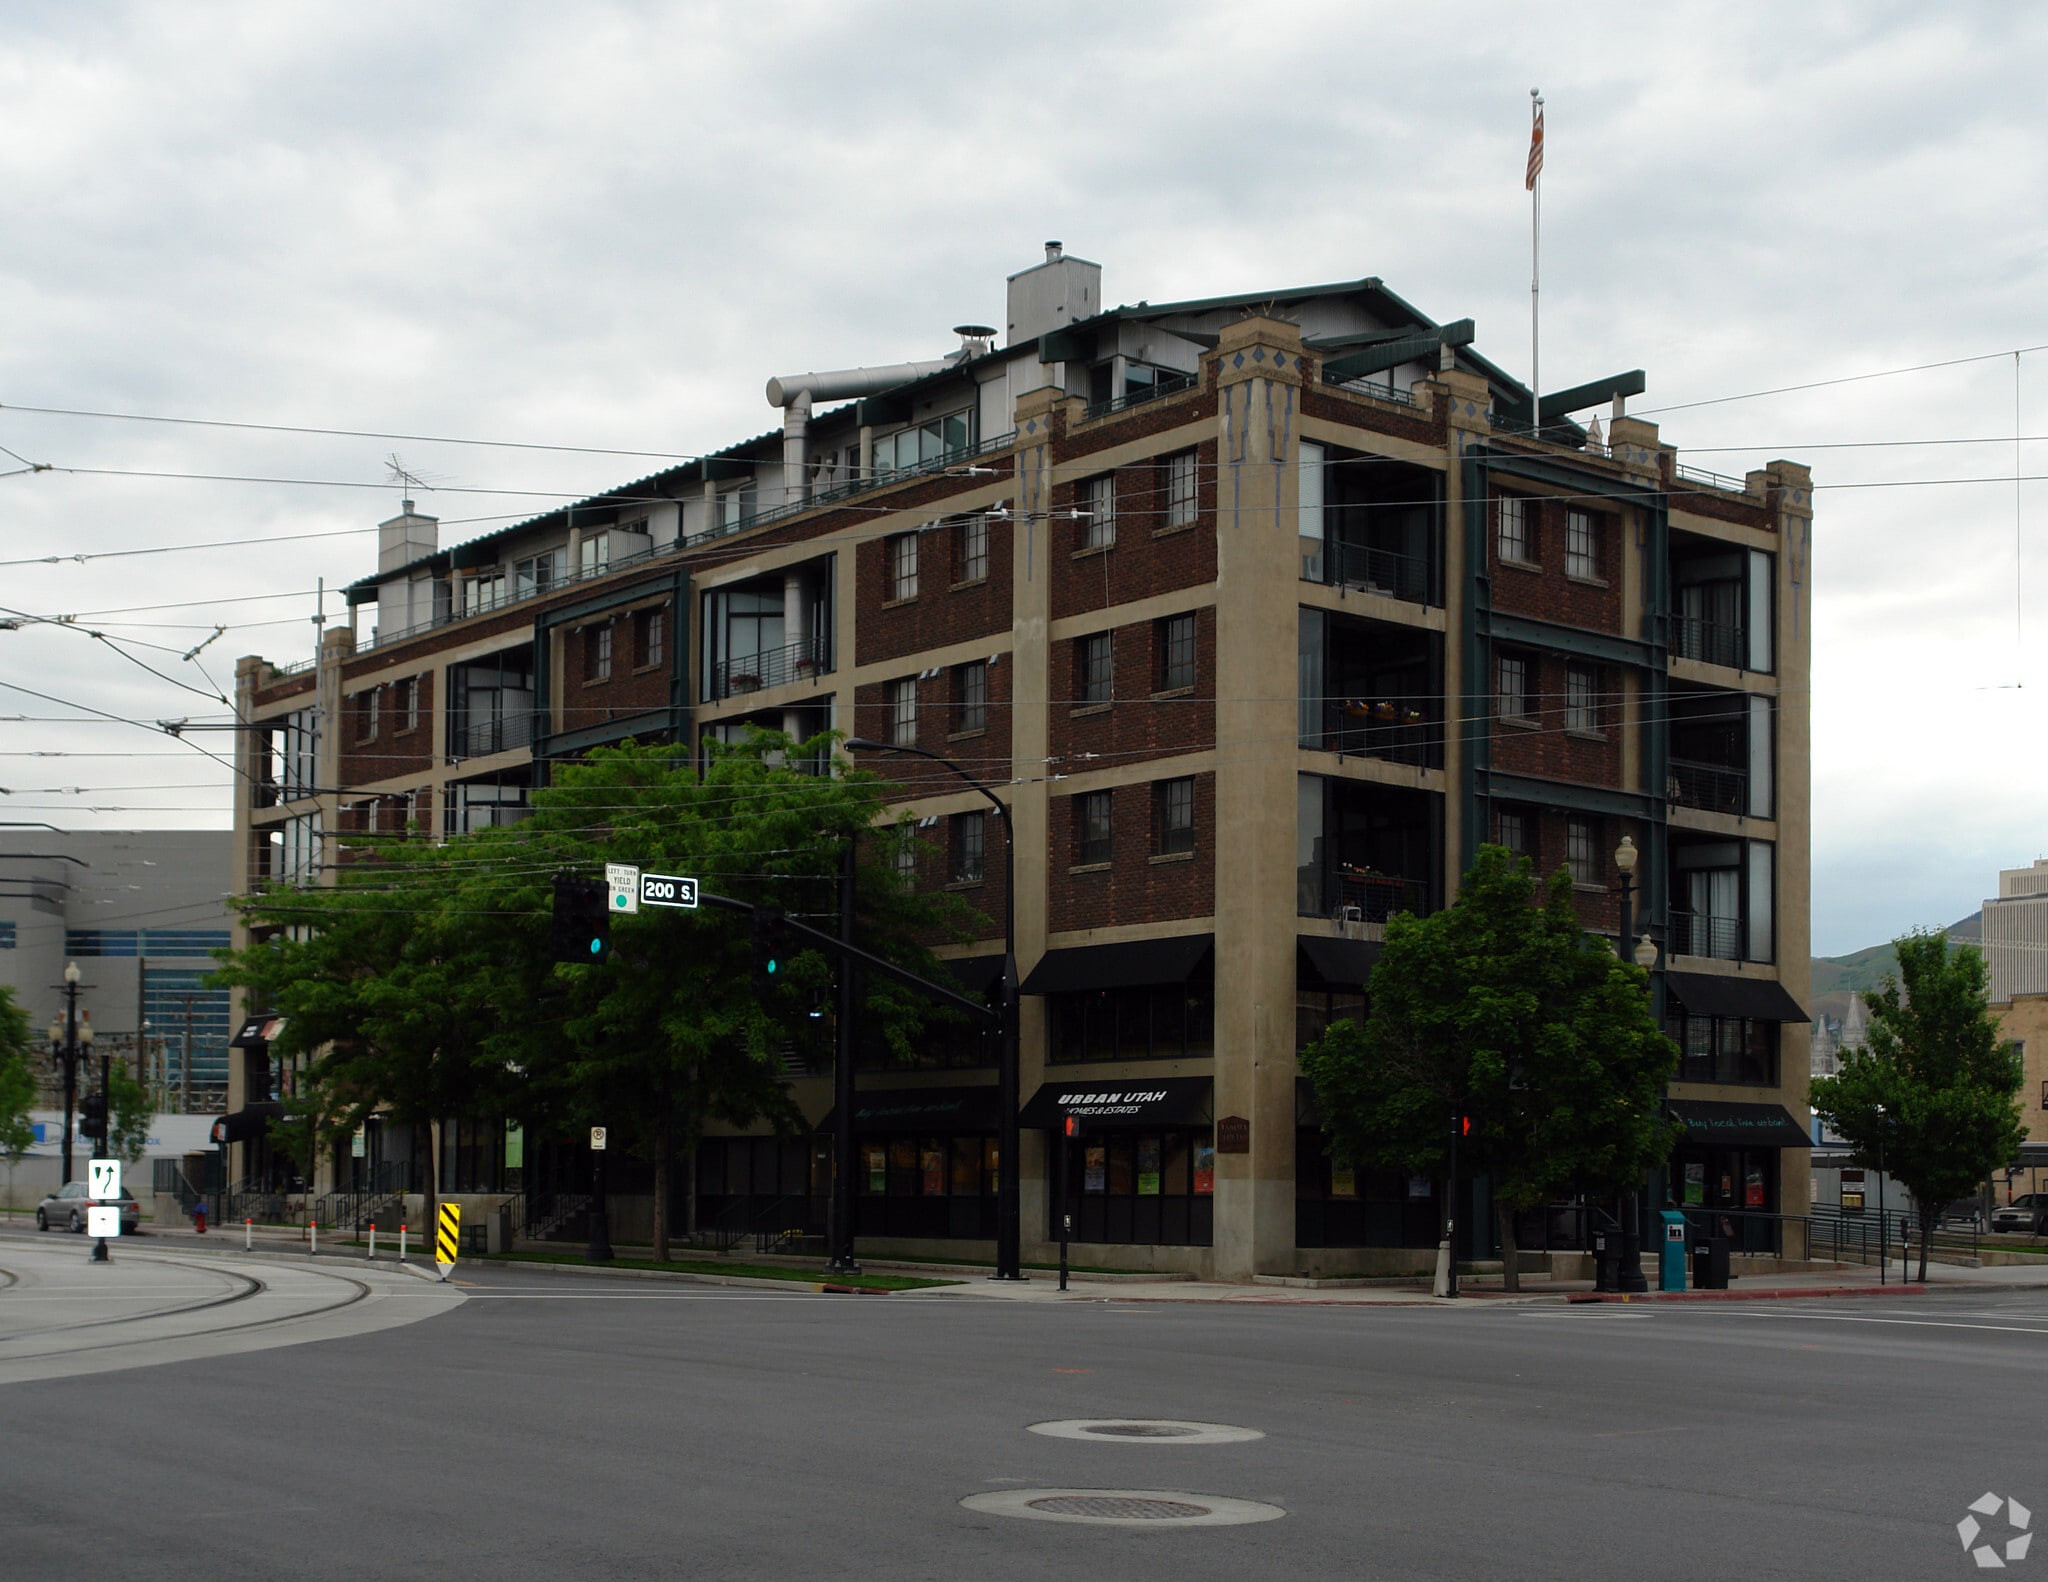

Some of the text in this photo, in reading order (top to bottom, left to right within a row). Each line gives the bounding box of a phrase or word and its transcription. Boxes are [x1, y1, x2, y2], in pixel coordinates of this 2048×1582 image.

[614, 876, 631, 885] YIELD
[645, 881, 694, 901] 200 S.
[1058, 1090, 1168, 1105] URBAN UTAH
[1103, 1105, 1142, 1115] ESTATES
[1687, 1117, 1708, 1130] Buy
[1669, 1225, 1682, 1237] in
